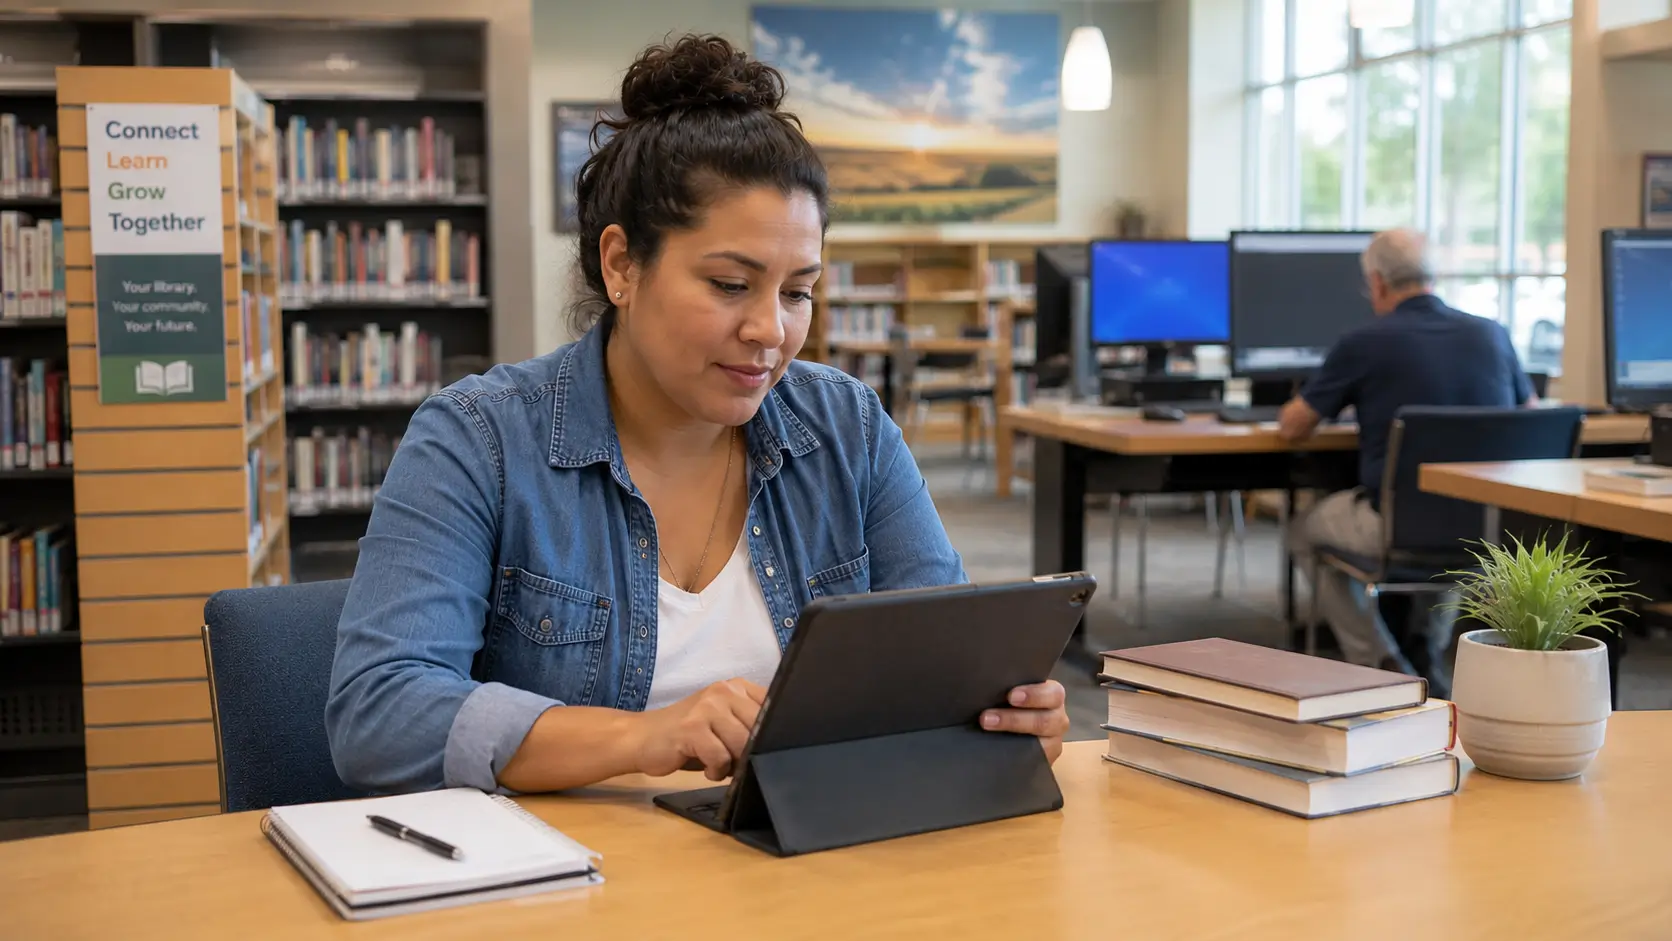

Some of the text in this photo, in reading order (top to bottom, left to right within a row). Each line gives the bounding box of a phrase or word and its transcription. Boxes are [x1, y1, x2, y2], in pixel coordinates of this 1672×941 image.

[105, 120, 200, 140] Connect
[106, 151, 168, 170] Learn
[107, 181, 166, 200] Grow
[108, 212, 206, 235] Together
[122, 280, 198, 295] Your library.
[112, 300, 210, 315] Your community.
[124, 319, 198, 333] Your future.
